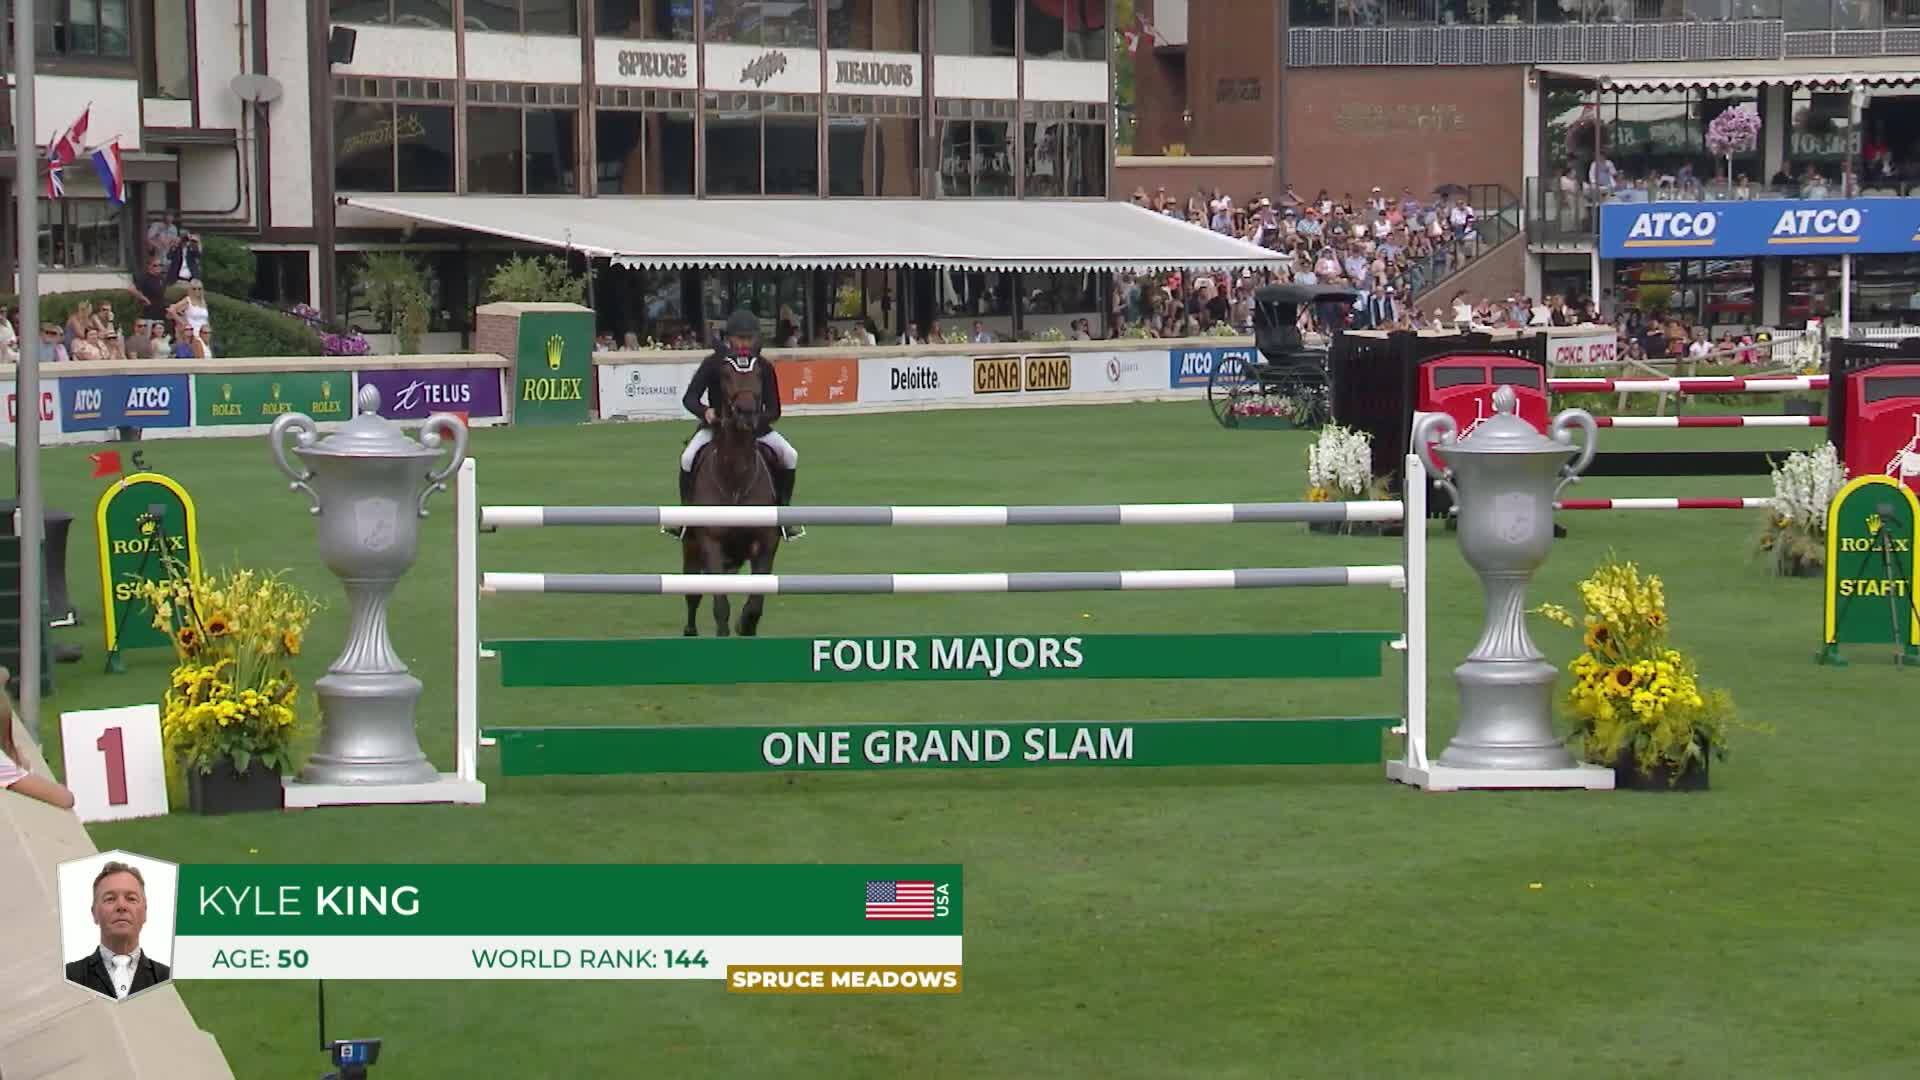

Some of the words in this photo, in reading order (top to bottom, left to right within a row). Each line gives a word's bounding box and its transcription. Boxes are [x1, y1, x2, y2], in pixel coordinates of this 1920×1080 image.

[835, 60, 913, 88] MEADOWS
[1629, 212, 1716, 238] ATCO
[1773, 208, 1861, 235] ATCO
[977, 361, 1018, 389] CANA
[1028, 359, 1069, 387] CANA
[1181, 352, 1212, 375] ATCO
[75, 389, 101, 411] ATCO
[127, 387, 170, 408] ATCO
[424, 384, 470, 403] TELUS
[523, 378, 582, 401] ROLEX
[212, 404, 242, 416] ROLEX
[312, 401, 341, 413] ROLEX
[812, 640, 920, 672] FOUR
[930, 637, 1084, 677] MAJORS
[762, 731, 851, 766] ONE
[863, 729, 1012, 764] GRAND
[1022, 727, 1134, 761] SLAM
[97, 726, 128, 806] 1
